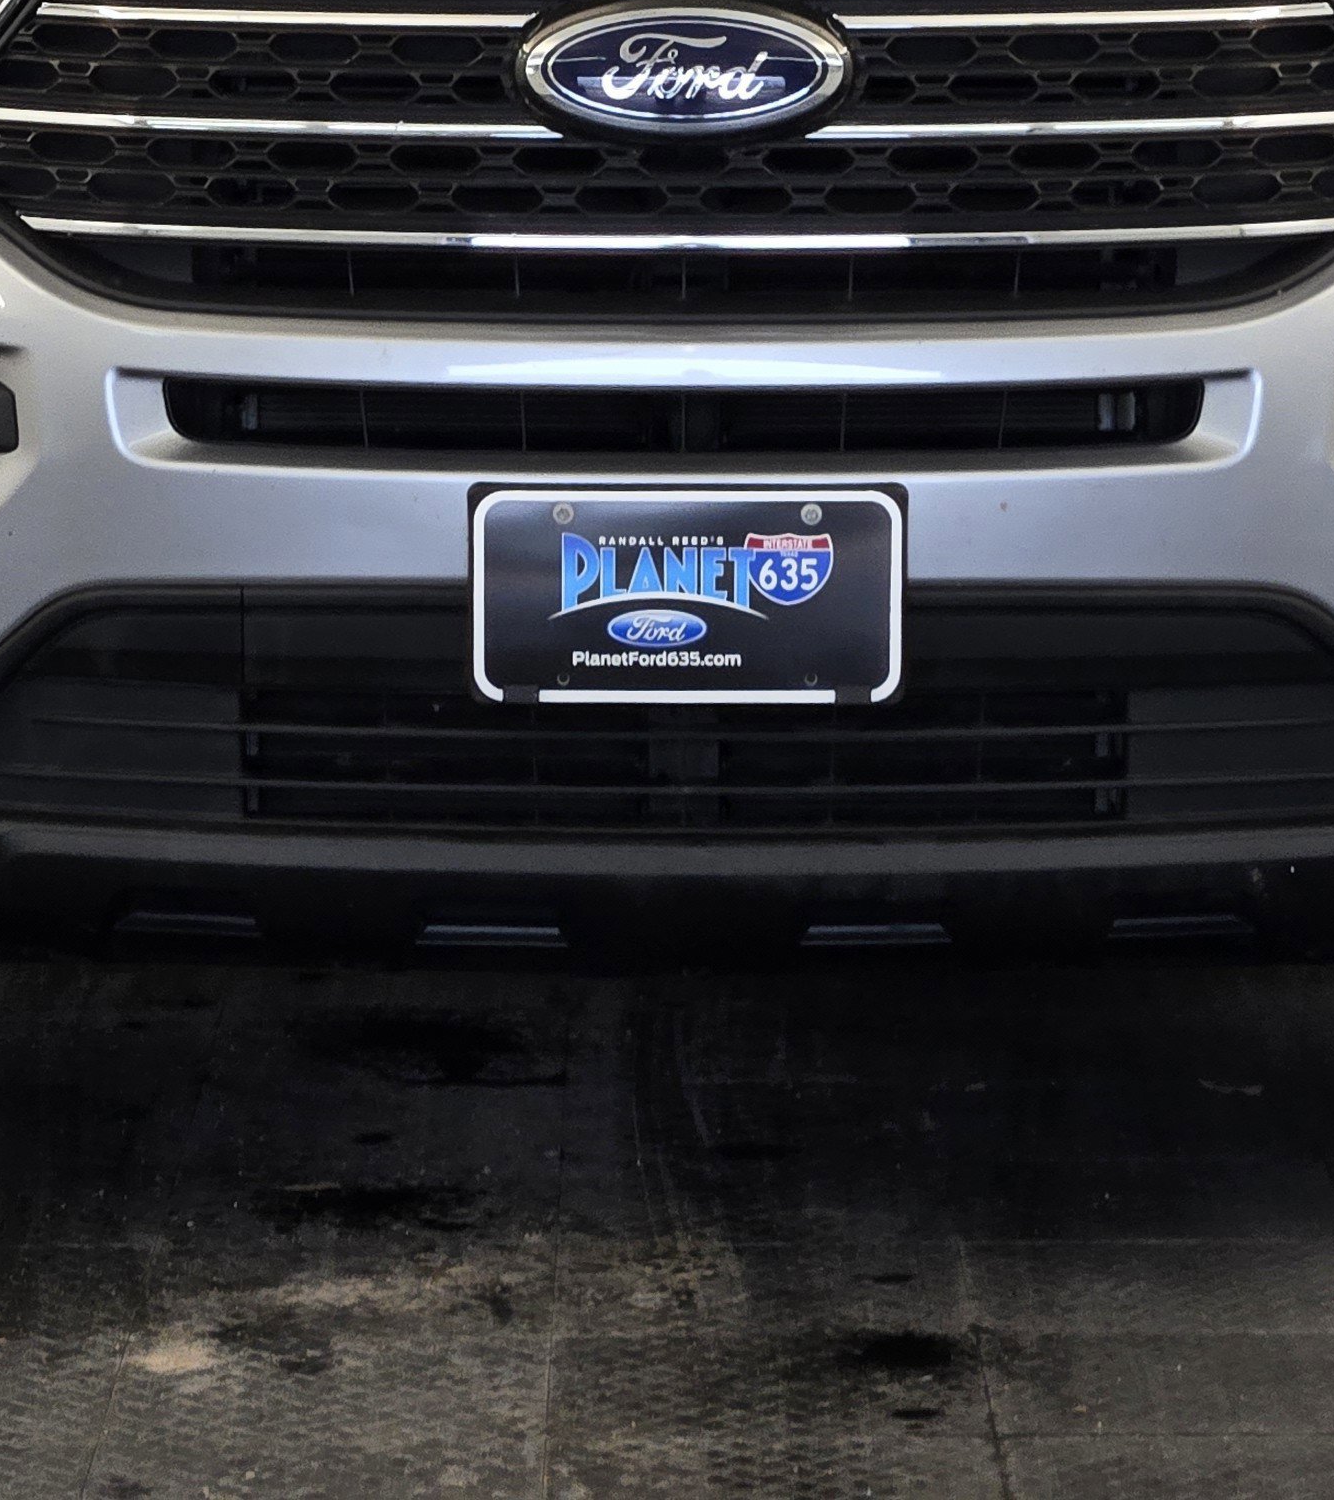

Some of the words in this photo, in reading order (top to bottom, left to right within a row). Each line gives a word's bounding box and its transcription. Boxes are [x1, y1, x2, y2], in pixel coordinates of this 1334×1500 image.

[601, 32, 769, 100] Ford
[598, 535, 664, 546] RANDALL
[763, 537, 812, 549] INTERSTATE
[562, 532, 756, 612] PLANET
[759, 557, 819, 591] 635
[626, 614, 687, 642] Ford
[572, 651, 742, 667] PlanetFord635.com
